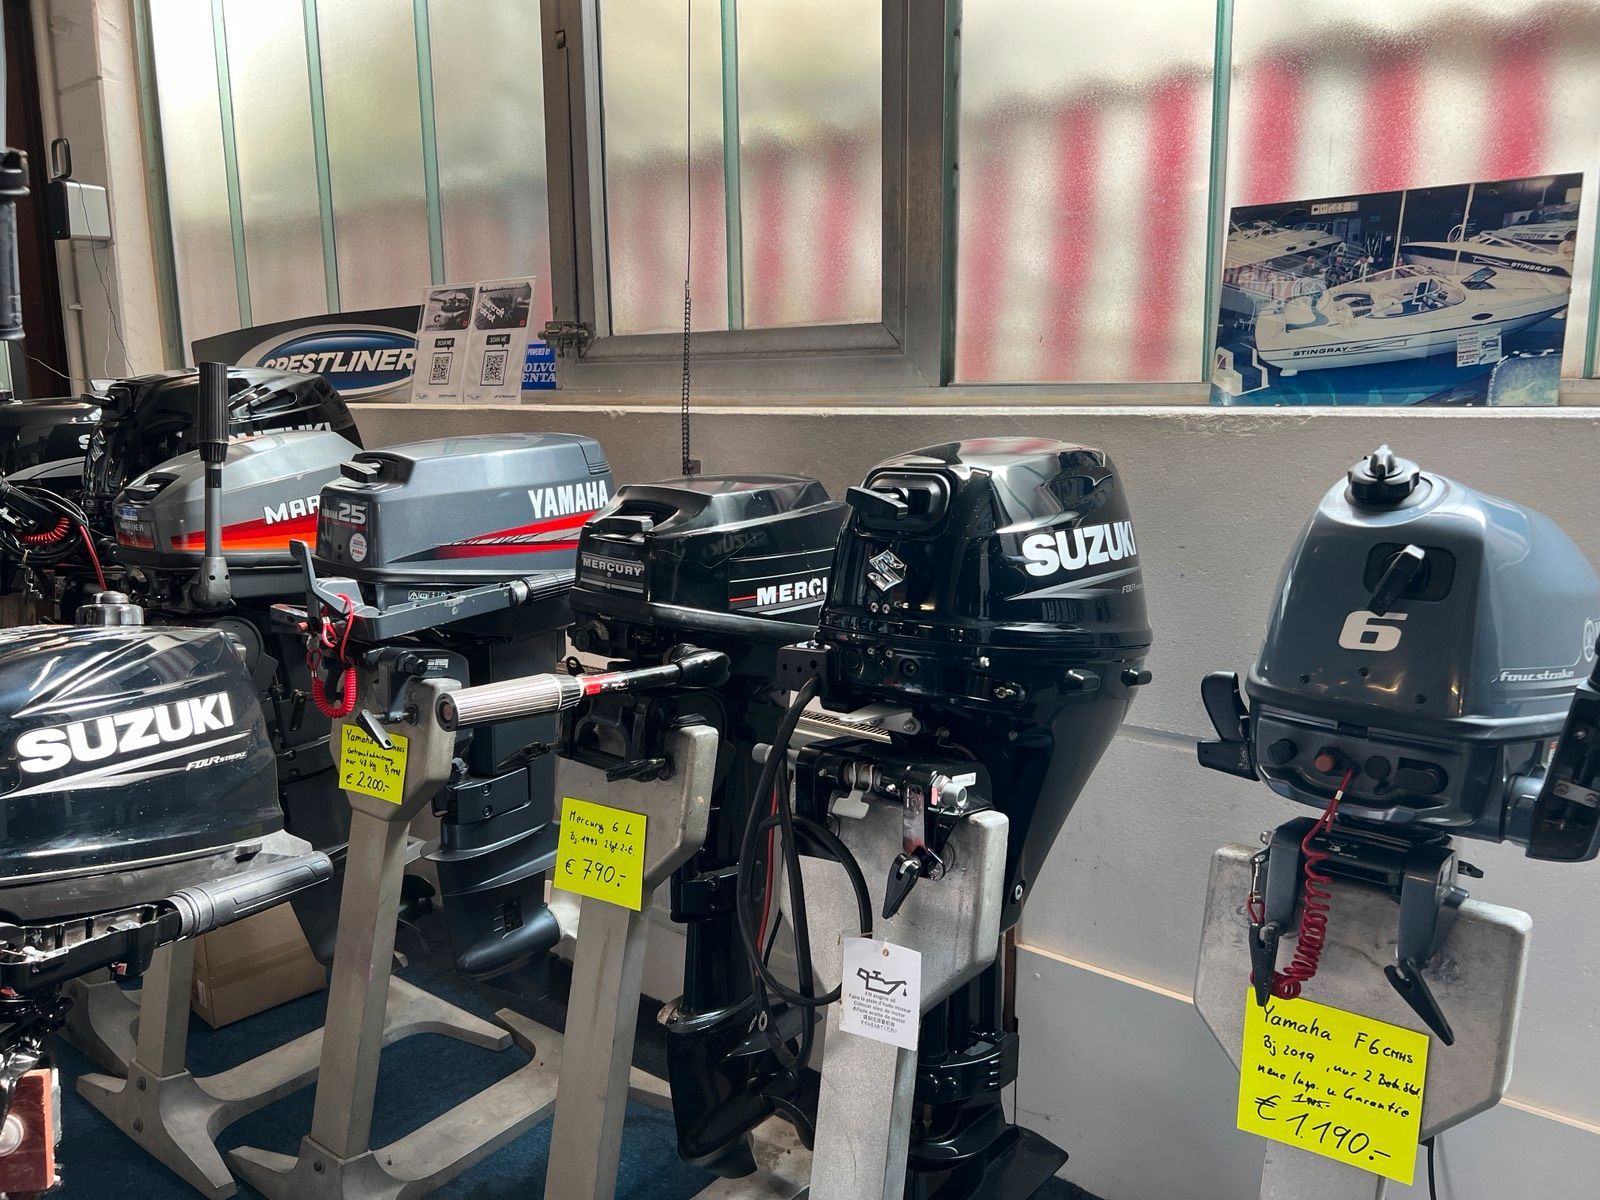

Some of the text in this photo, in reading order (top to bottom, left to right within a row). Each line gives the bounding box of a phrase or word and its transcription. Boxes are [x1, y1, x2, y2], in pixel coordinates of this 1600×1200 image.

[1510, 262, 1553, 273] STINGRAY
[1293, 346, 1348, 356] STINGRAY
[522, 373, 556, 383] ENTA
[525, 362, 556, 373] OLVO
[528, 480, 609, 519] YAMAHA
[338, 502, 366, 525] 25
[1022, 520, 1137, 577] SUZUKI
[582, 557, 645, 577] MERCURY
[1338, 610, 1409, 652] 6
[17, 692, 234, 774] SUZUKI
[346, 728, 374, 745] Yamaha
[569, 810, 633, 836] Mercury 6 L
[565, 858, 576, 875] €
[1263, 1005, 1332, 1041] Yamaha
[1263, 1034, 1277, 1056] Bj
[1283, 1045, 1315, 1063] 2019
[1363, 1069, 1373, 1083] 2
[1254, 1094, 1281, 1121] €
[1343, 1087, 1410, 1118] Garantie
